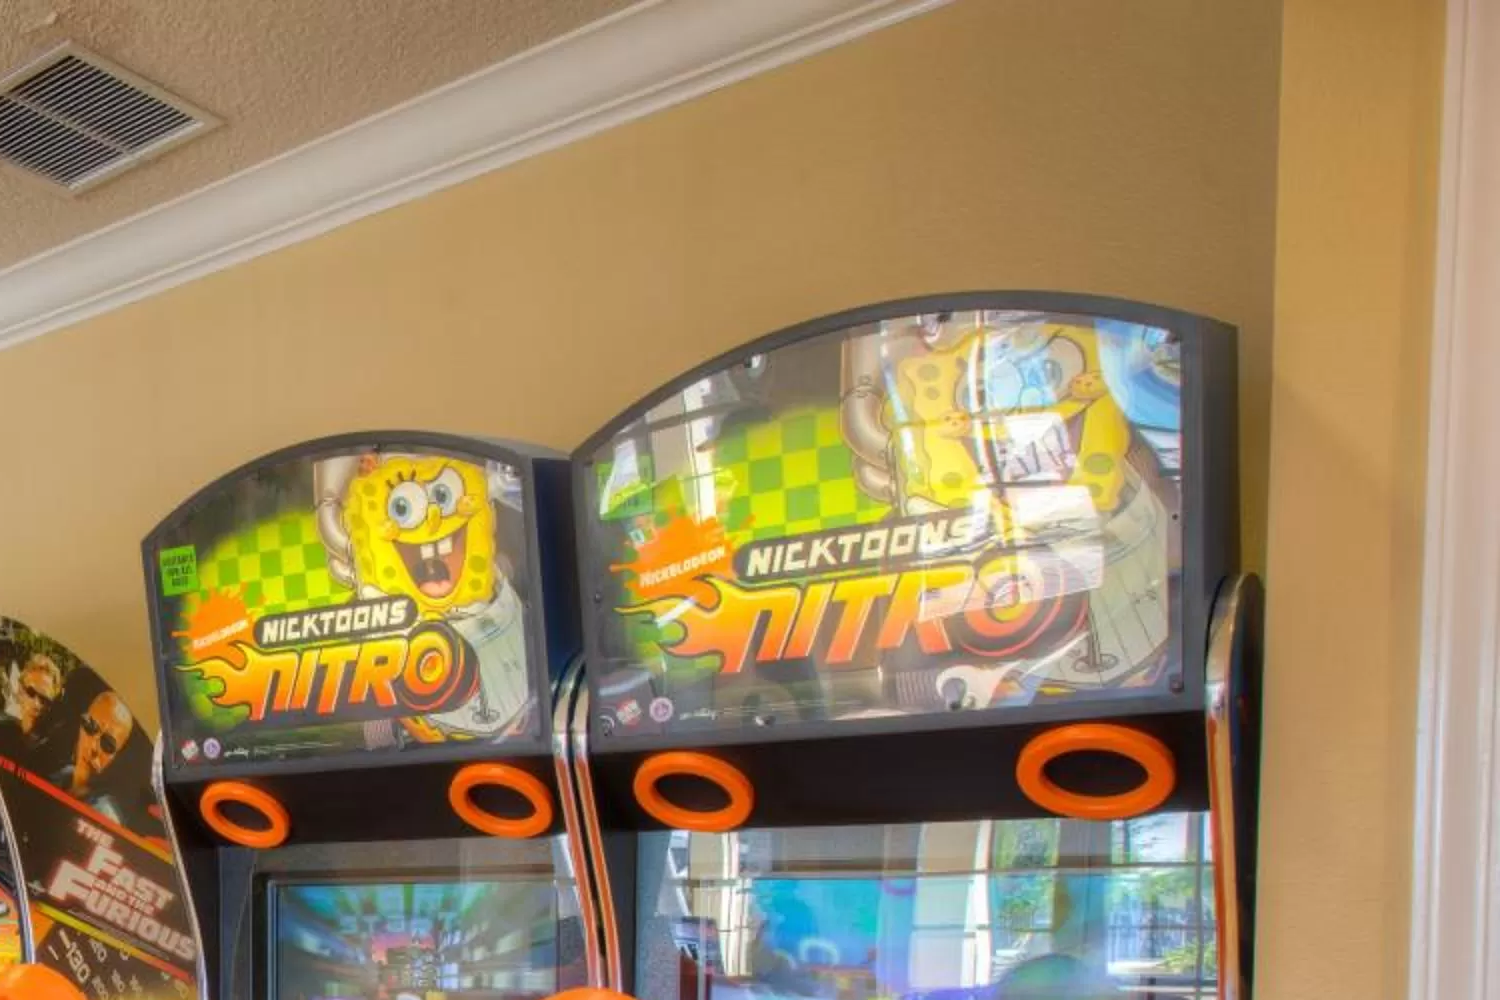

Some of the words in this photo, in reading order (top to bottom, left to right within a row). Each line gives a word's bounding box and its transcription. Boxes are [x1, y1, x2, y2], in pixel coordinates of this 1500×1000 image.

[746, 514, 975, 577] NICKTOONS
[262, 599, 410, 644] NICKTOONS
[690, 557, 1048, 673] NITRO
[228, 628, 457, 720] NITRO
[49, 859, 198, 962] FURIOUS
[88, 846, 176, 910] FAST
